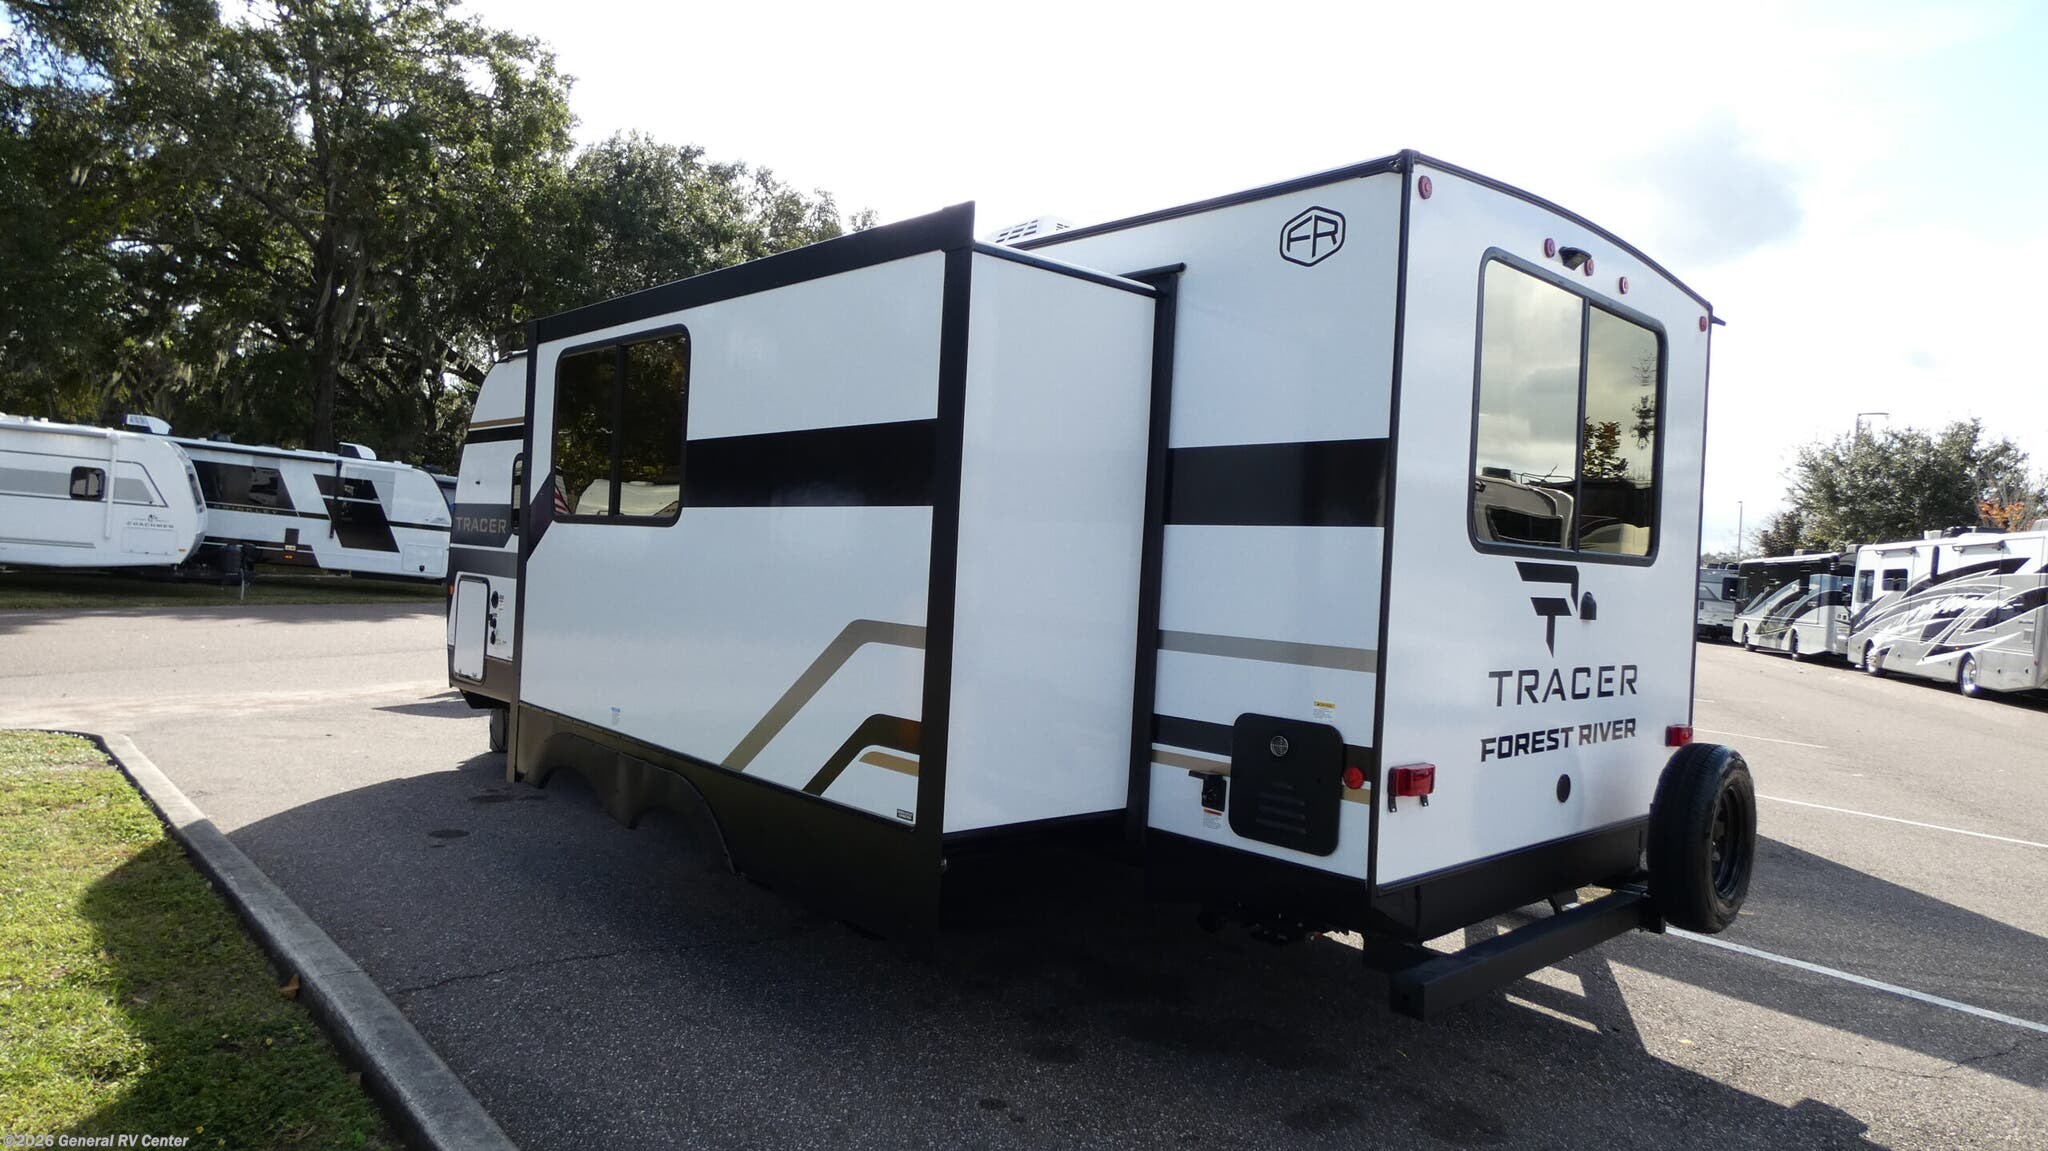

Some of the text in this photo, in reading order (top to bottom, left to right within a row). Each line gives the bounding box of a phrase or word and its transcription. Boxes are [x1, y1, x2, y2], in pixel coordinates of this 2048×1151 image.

[455, 516, 507, 534] TRACER
[1488, 664, 1638, 707] TRACER
[1480, 718, 1636, 762] FOREST RIVER
